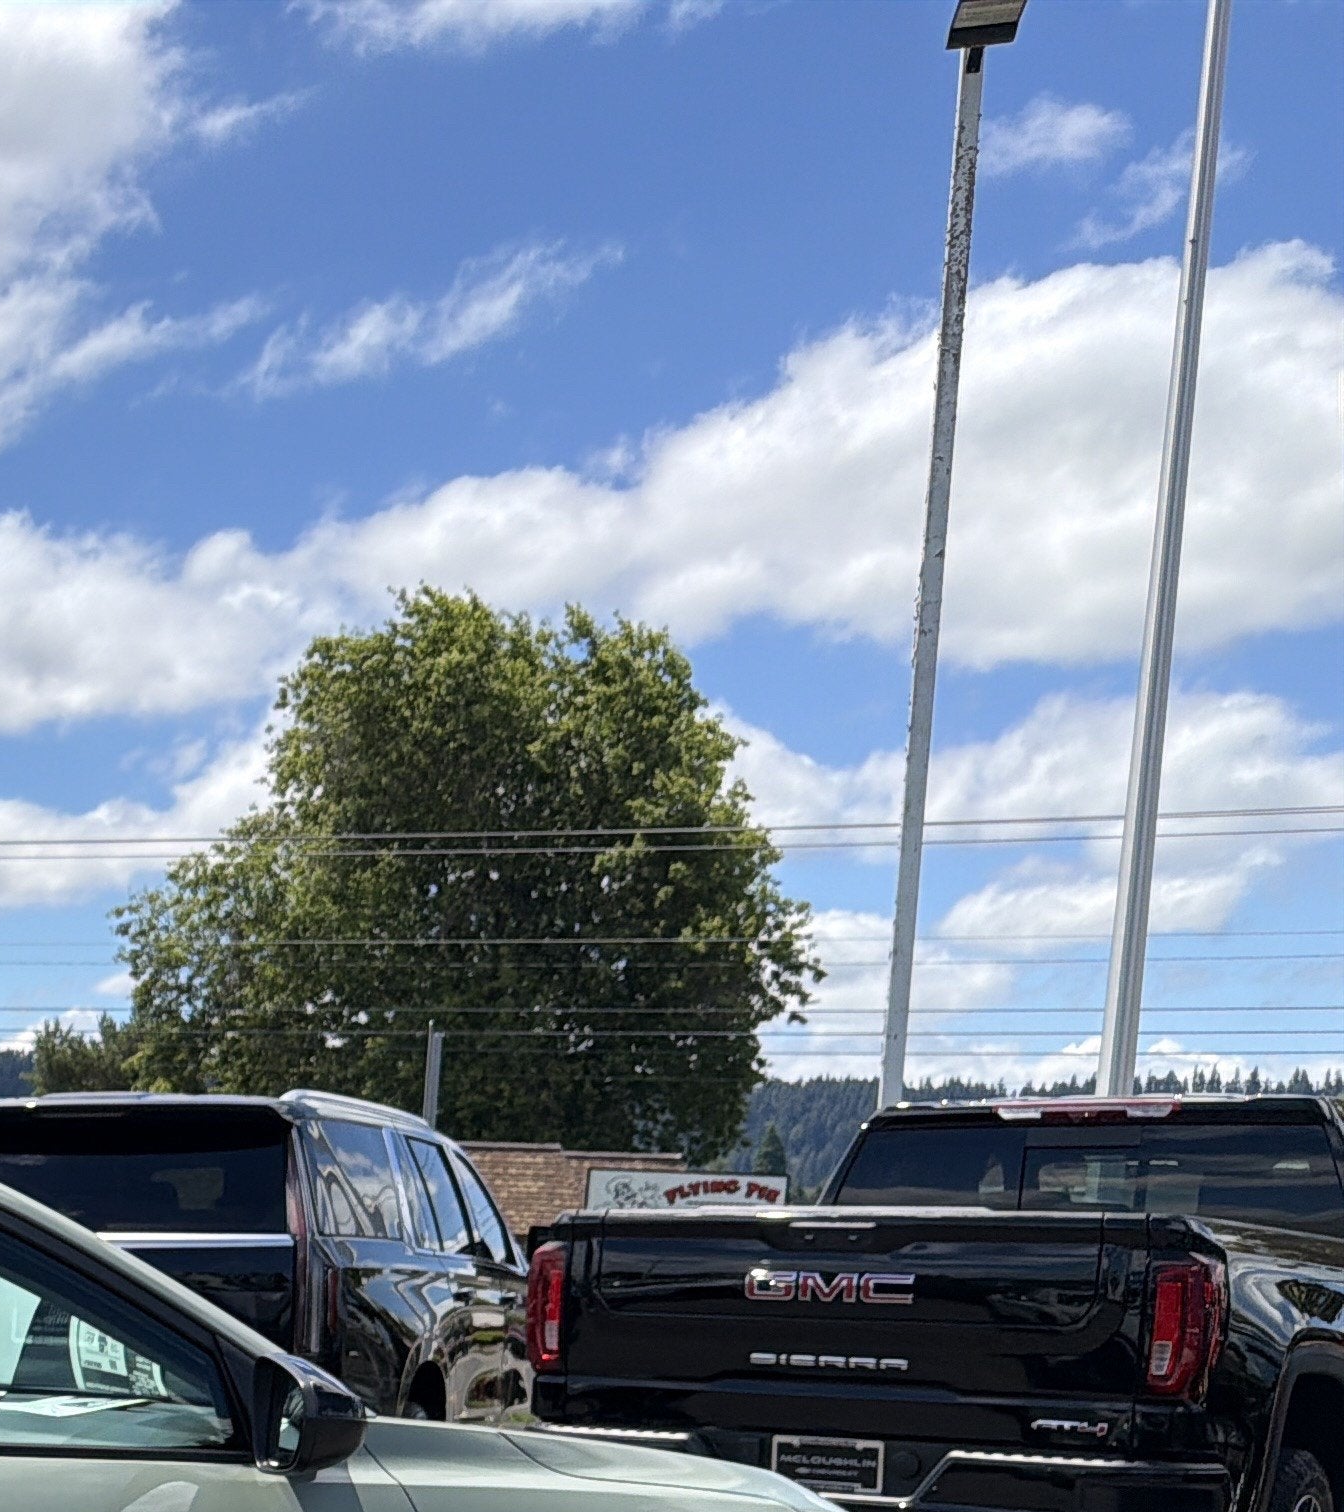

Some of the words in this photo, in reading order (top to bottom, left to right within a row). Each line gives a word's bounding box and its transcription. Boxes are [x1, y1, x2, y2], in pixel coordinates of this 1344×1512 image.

[664, 1179, 741, 1206] FLYING
[745, 1269, 916, 1305] GMC
[749, 1352, 909, 1371] SIERRA
